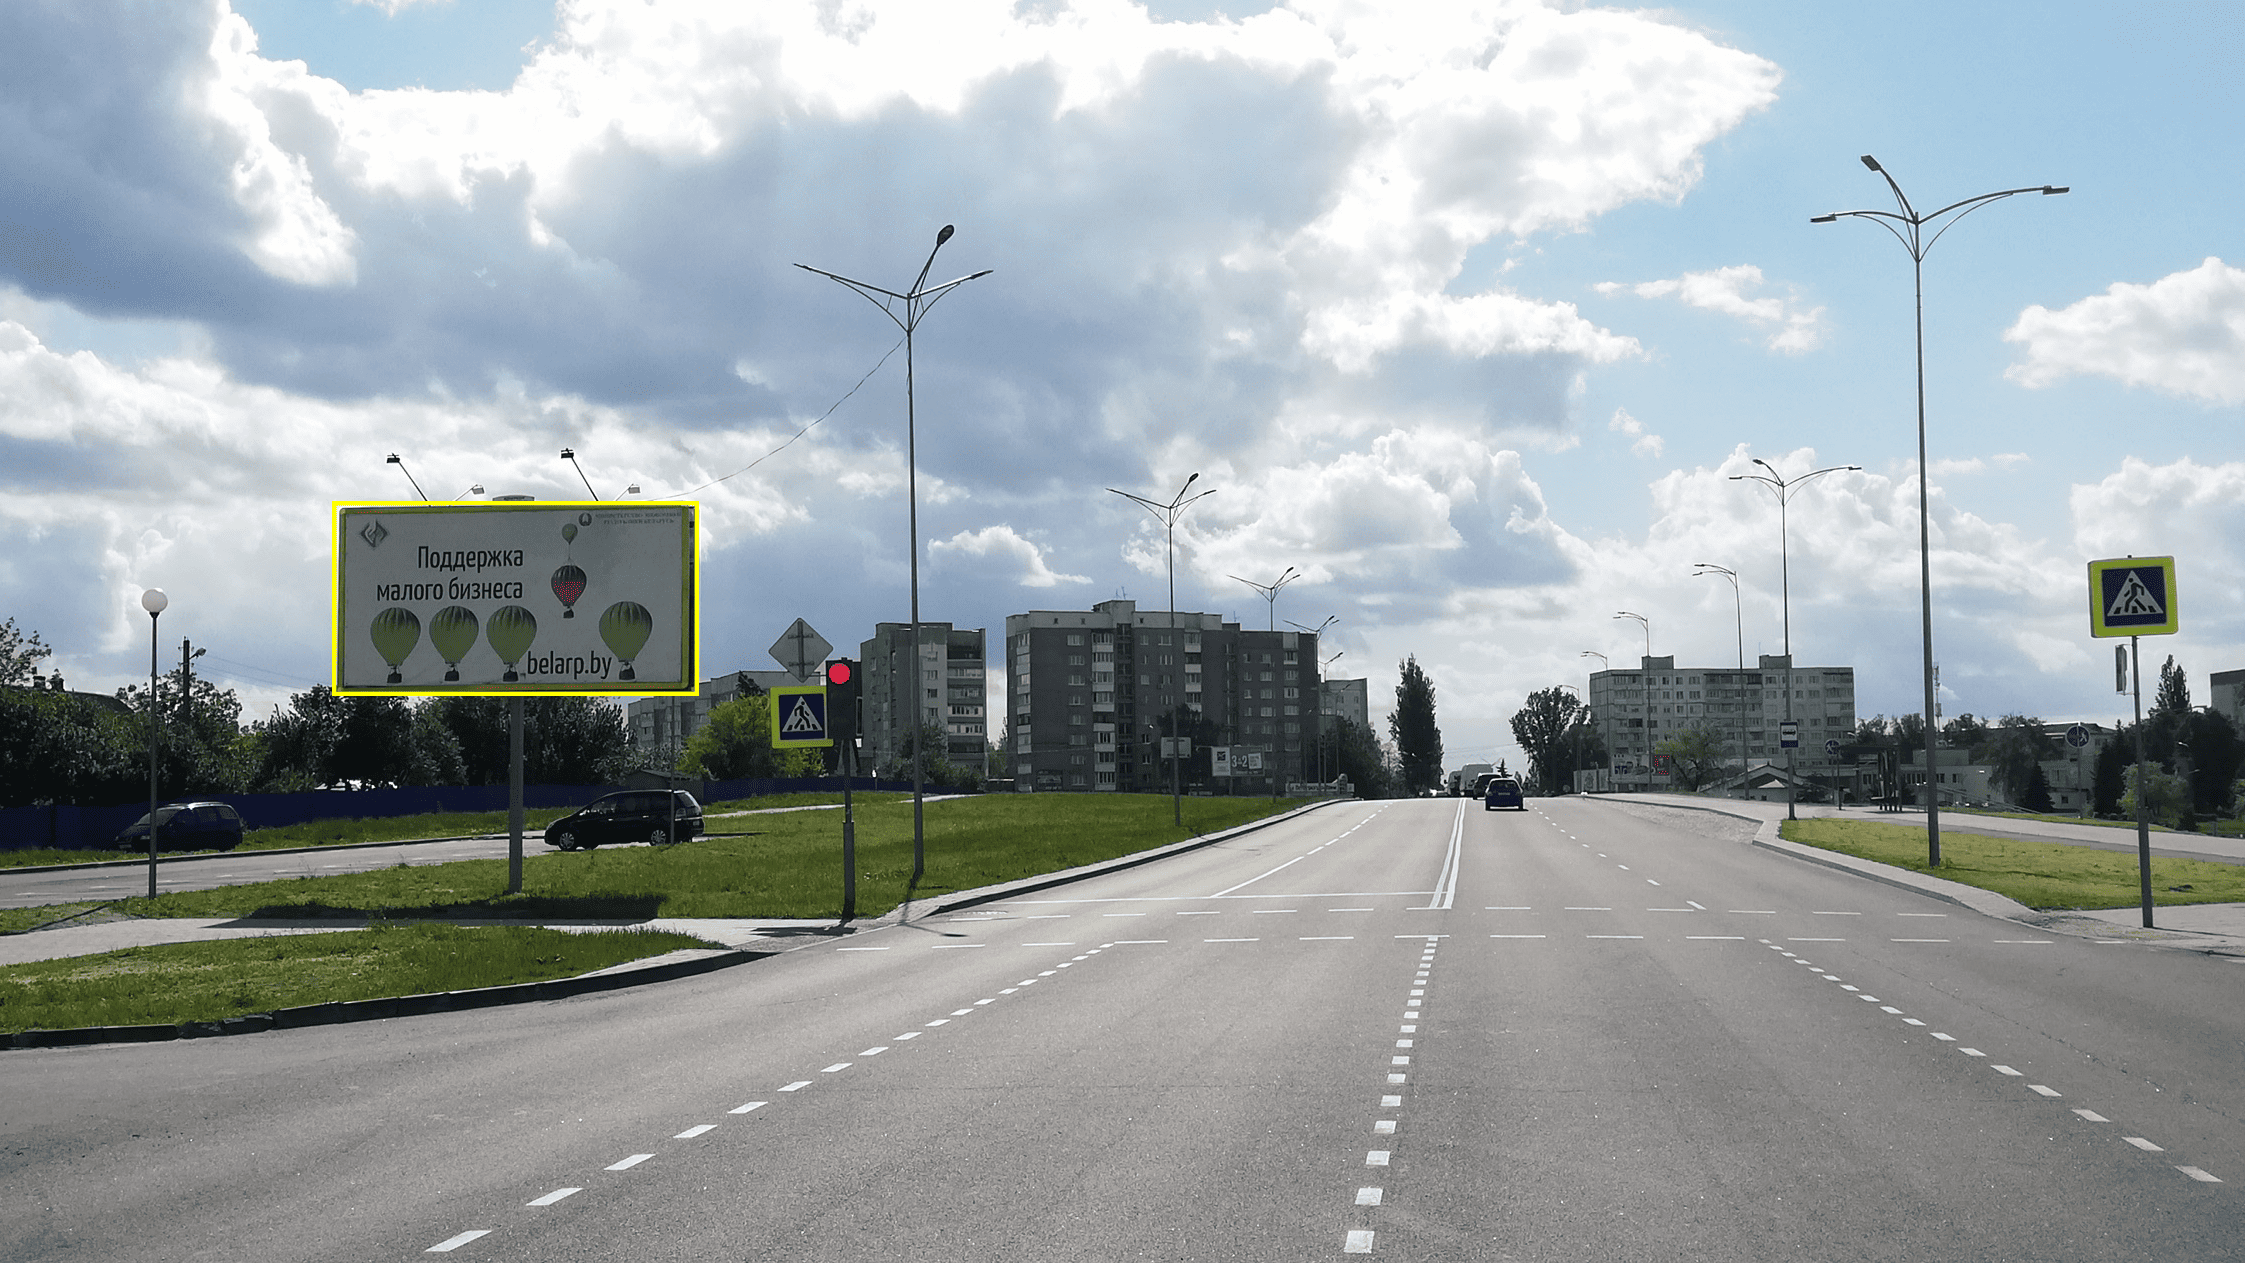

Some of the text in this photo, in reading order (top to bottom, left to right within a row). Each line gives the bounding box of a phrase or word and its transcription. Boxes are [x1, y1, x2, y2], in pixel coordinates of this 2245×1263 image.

[418, 546, 524, 573] Поддержка
[377, 577, 523, 601] малого бизнеса
[527, 650, 612, 679] belarp.by
